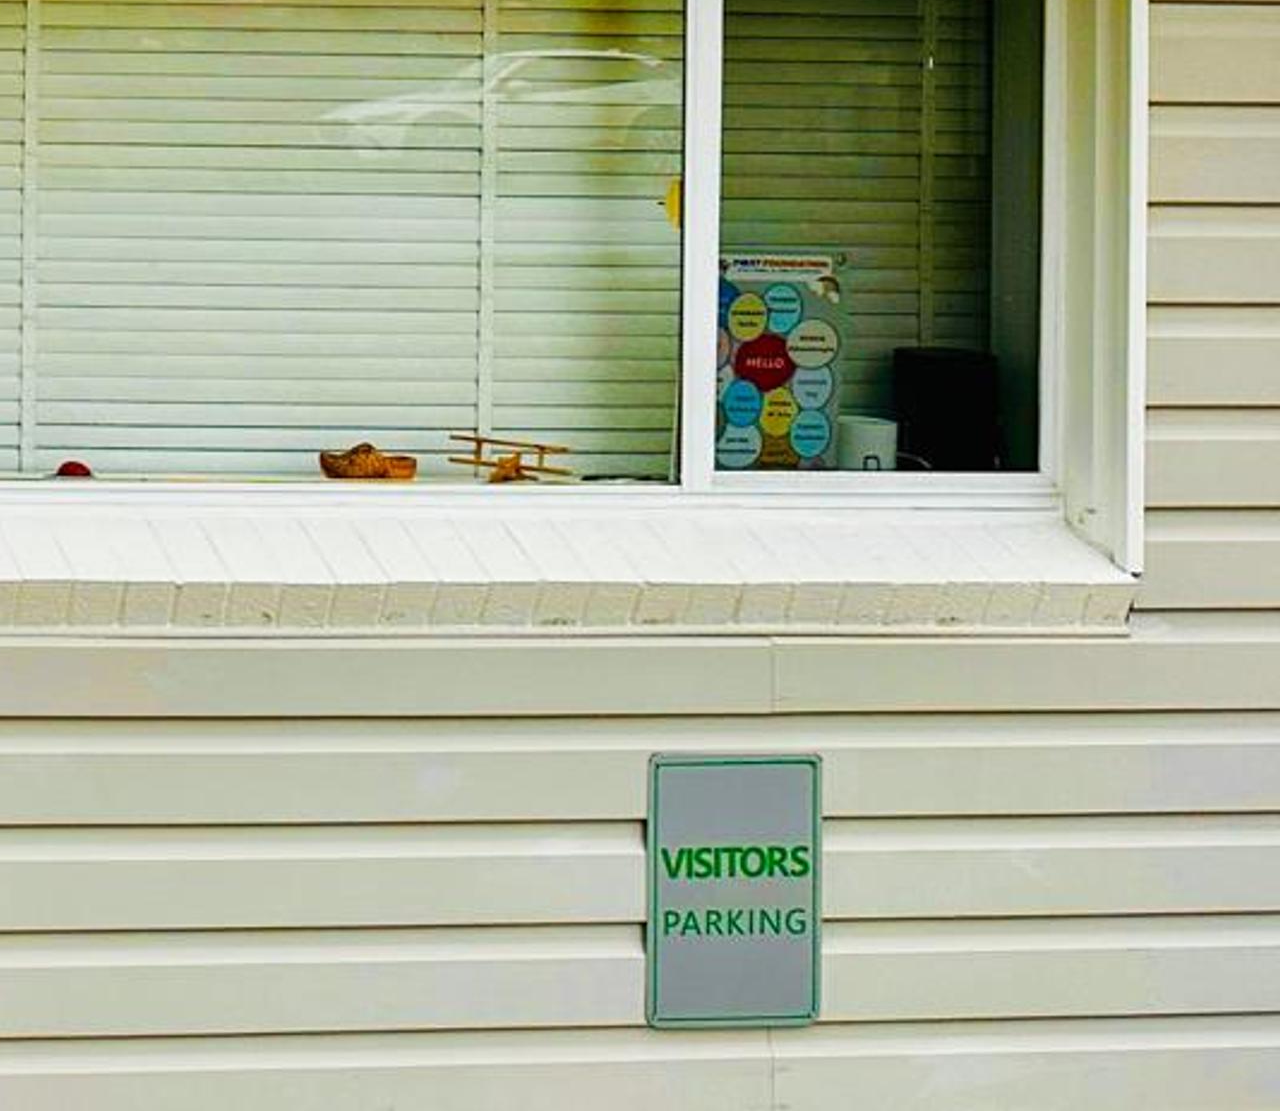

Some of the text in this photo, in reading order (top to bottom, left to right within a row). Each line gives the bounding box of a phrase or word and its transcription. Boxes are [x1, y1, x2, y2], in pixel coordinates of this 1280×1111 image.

[745, 356, 786, 370] HELLO
[660, 845, 811, 879] VISITORS
[662, 907, 807, 937] PARKING
